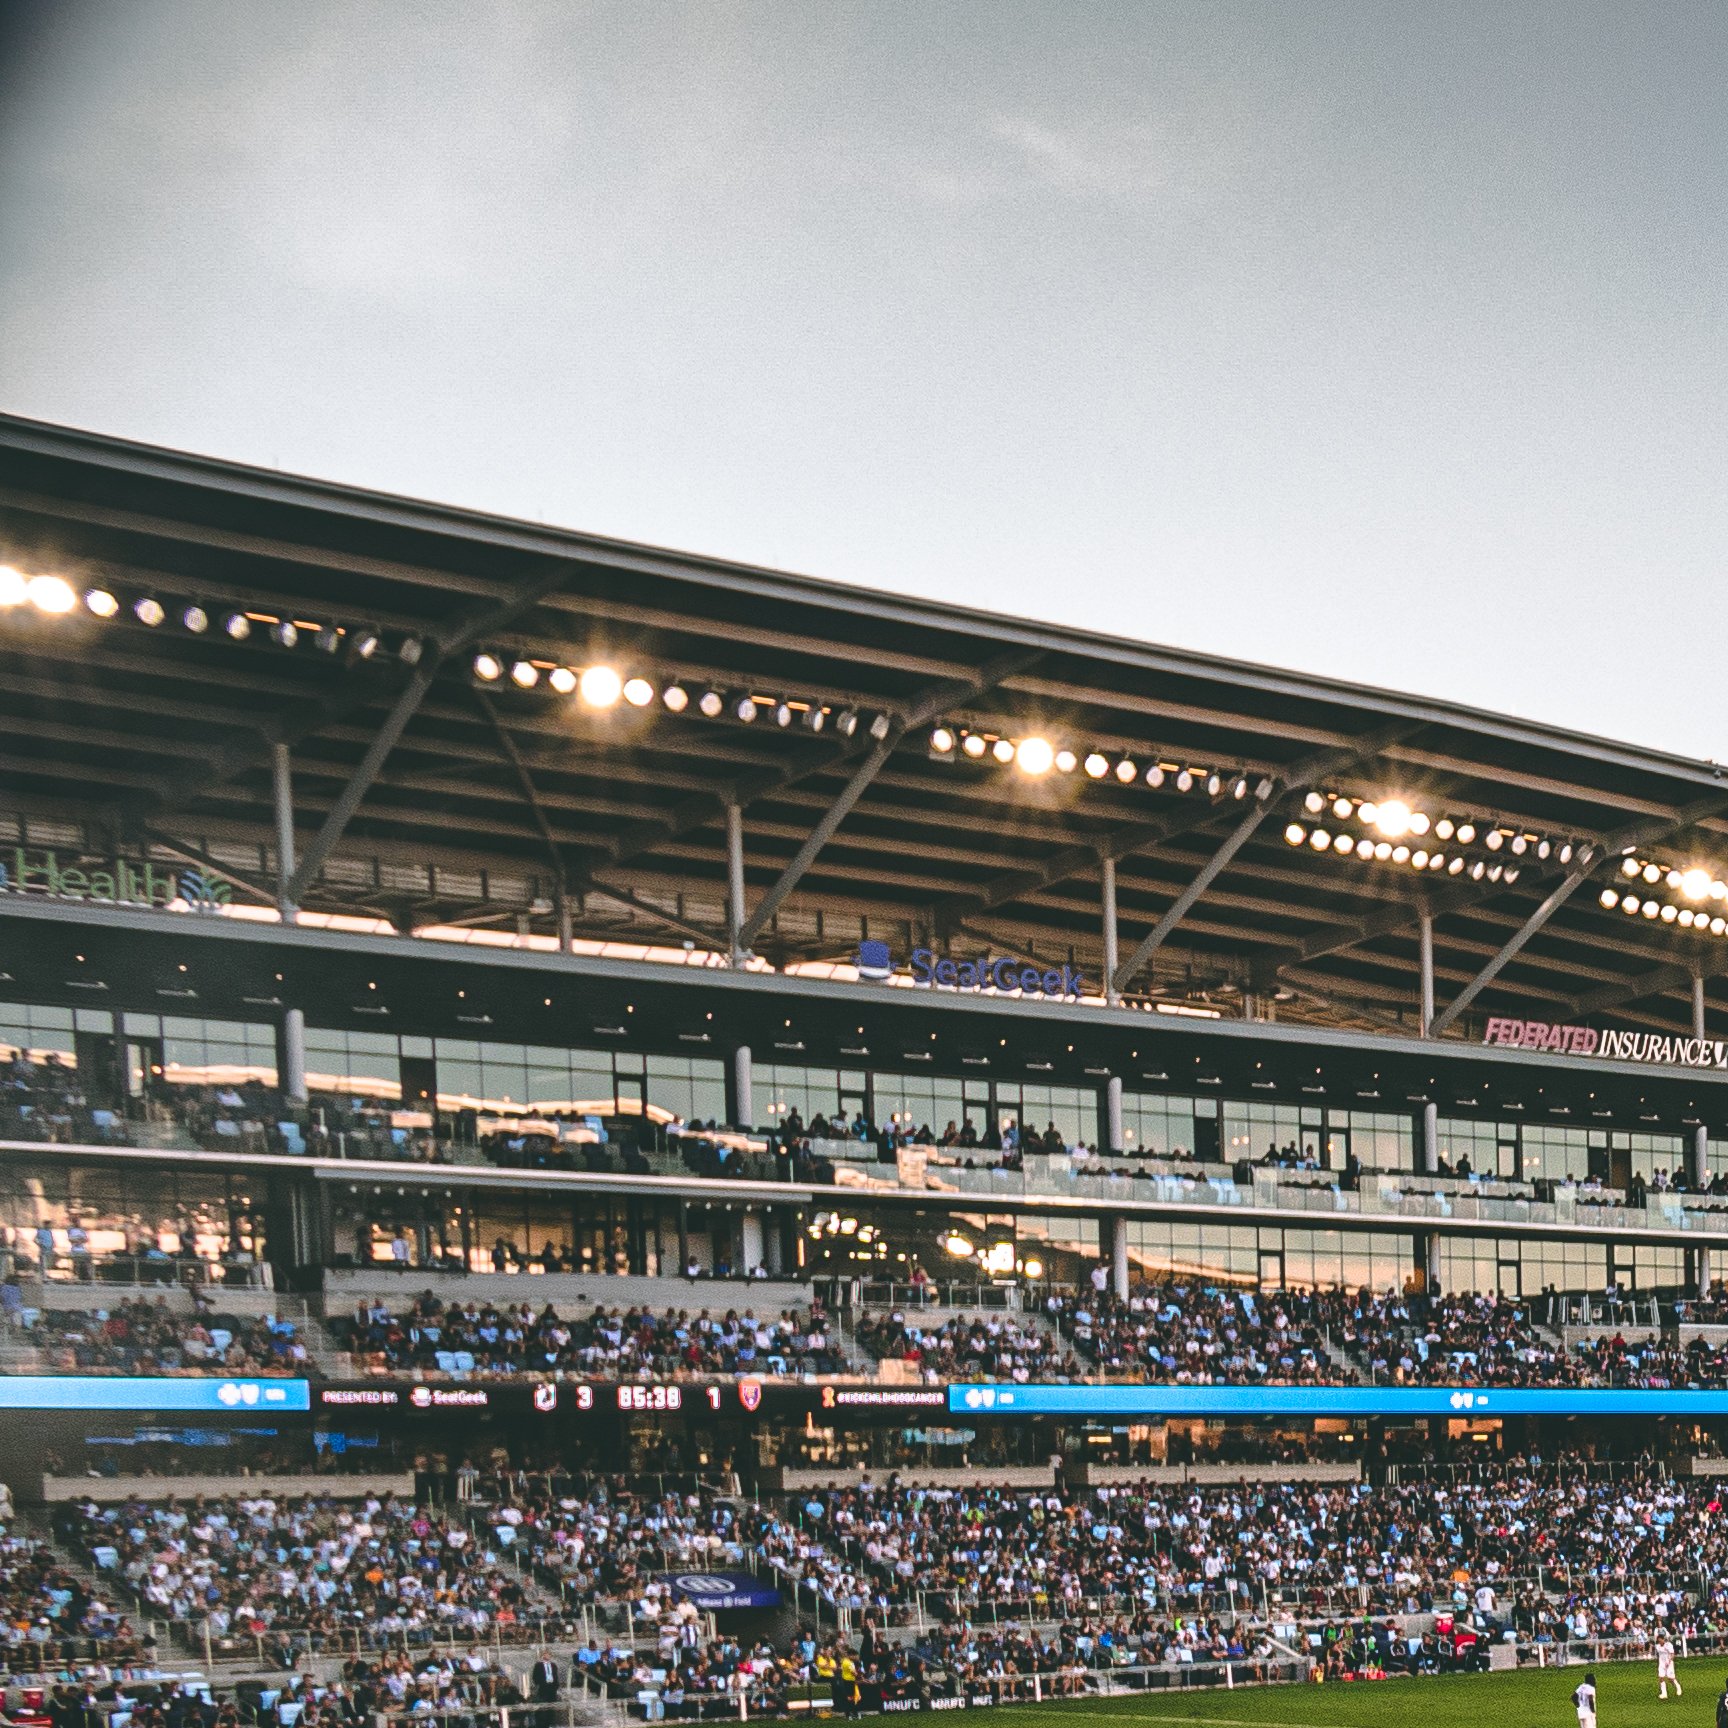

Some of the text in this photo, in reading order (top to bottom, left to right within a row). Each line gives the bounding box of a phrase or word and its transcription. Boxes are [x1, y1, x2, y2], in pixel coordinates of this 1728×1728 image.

[16, 848, 177, 902] Health
[911, 949, 1084, 997] SeatGeek
[1484, 1017, 1713, 1066] FEDERATED INSURANCE
[322, 1391, 381, 1403] PRESENTED
[576, 1386, 593, 1410] 3
[706, 1386, 721, 1410] 1
[883, 1698, 920, 1711] MNUFC
